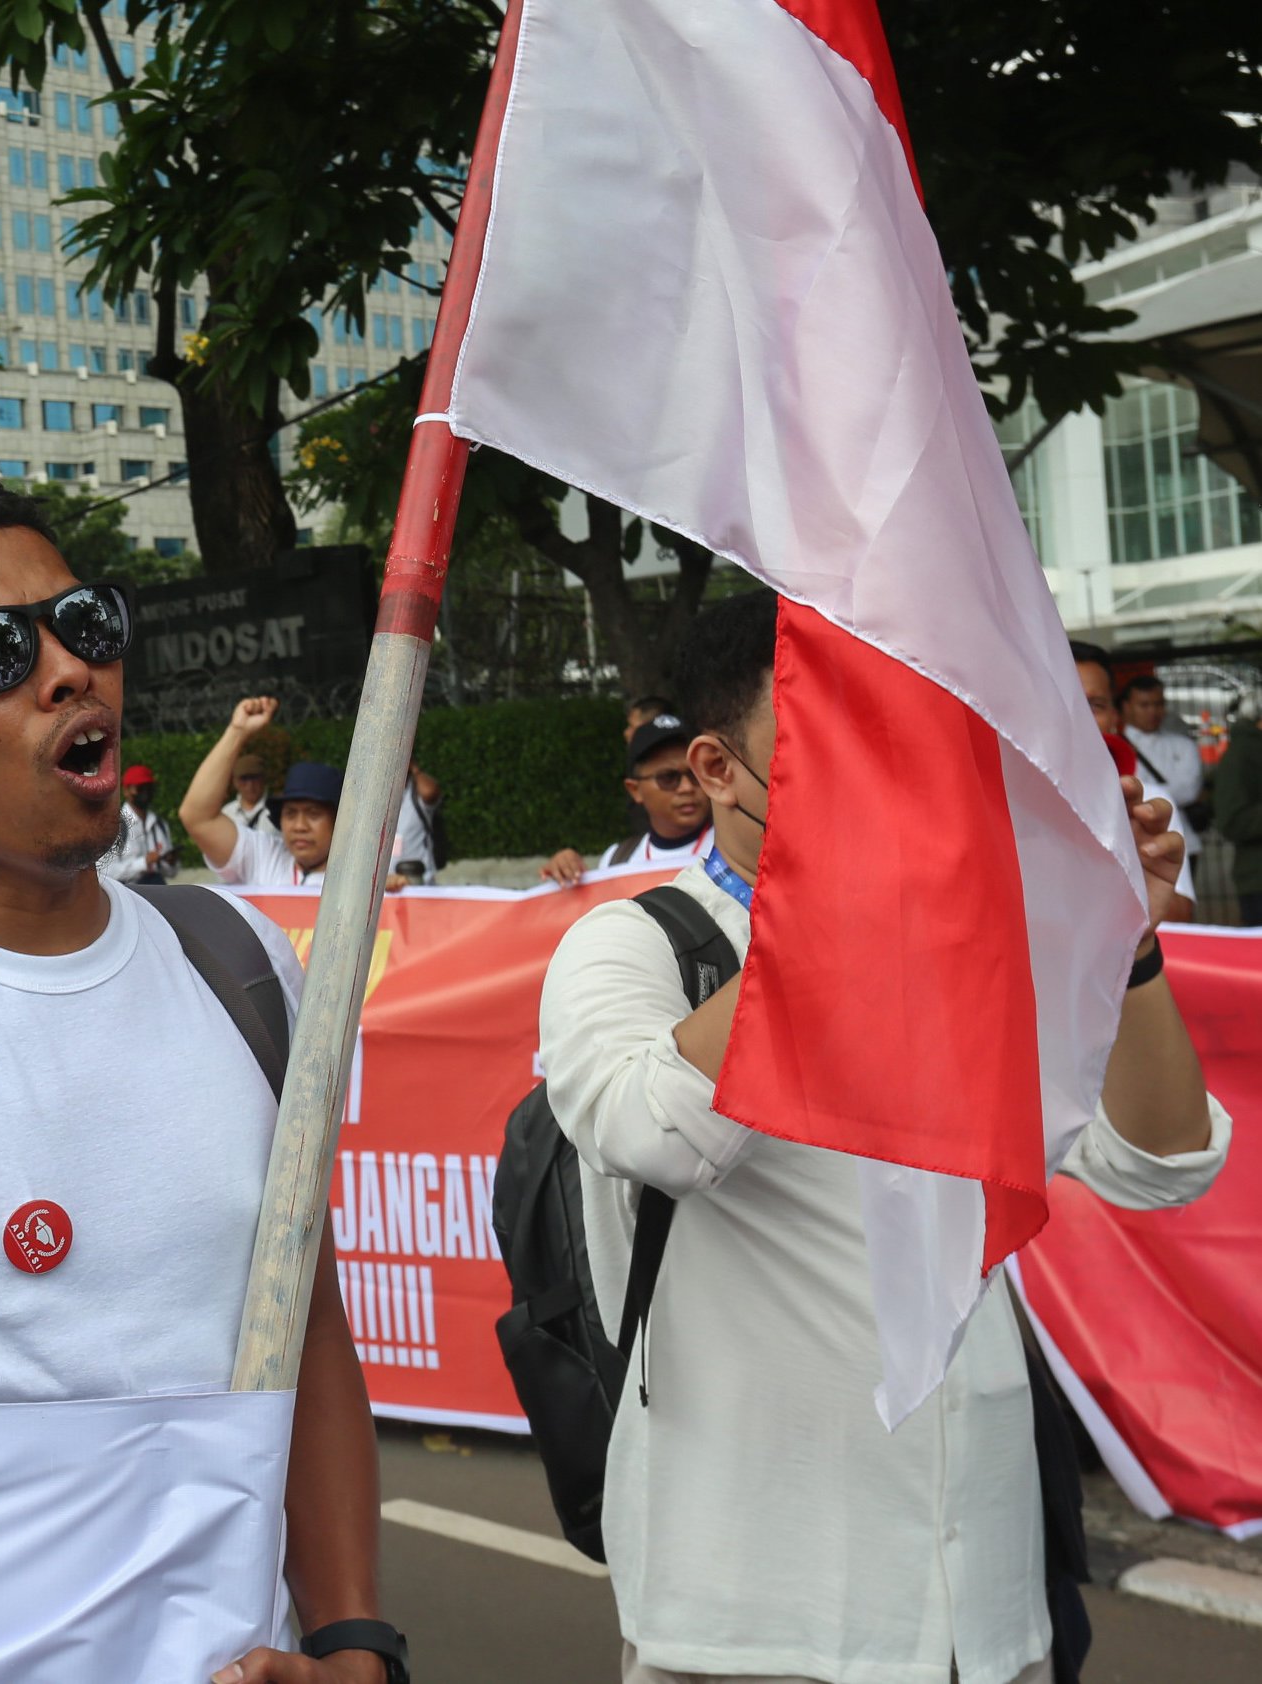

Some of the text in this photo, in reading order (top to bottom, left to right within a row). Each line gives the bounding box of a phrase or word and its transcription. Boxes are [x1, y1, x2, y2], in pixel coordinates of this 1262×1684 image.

[196, 588, 248, 615] PUSAT
[144, 615, 305, 676] INDOSAT
[332, 1150, 504, 1261] JANGAN
[11, 1224, 43, 1270] ADAKSI
